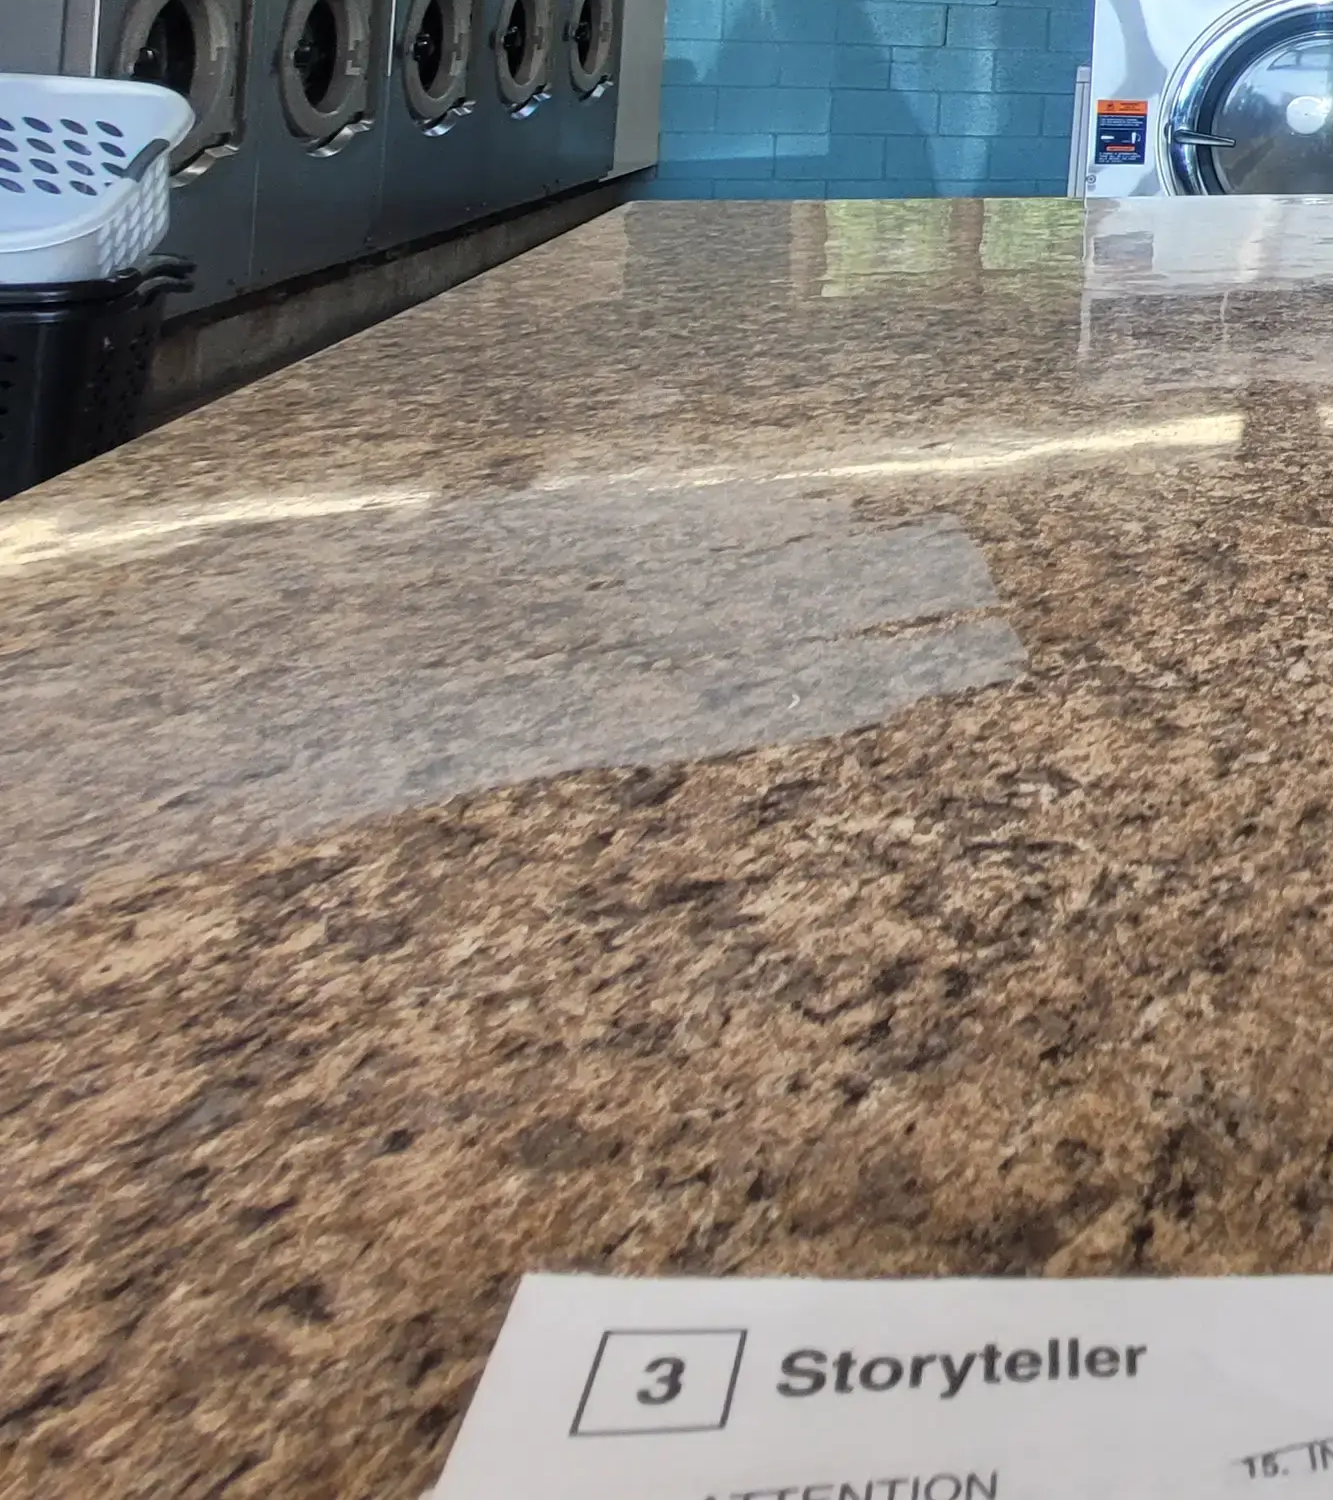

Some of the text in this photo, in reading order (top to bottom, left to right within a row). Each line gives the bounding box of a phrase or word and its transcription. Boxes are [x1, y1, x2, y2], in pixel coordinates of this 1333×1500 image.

[636, 1354, 687, 1405] 3
[775, 1338, 1148, 1399] Storyteller
[702, 1469, 999, 1500] NTION
